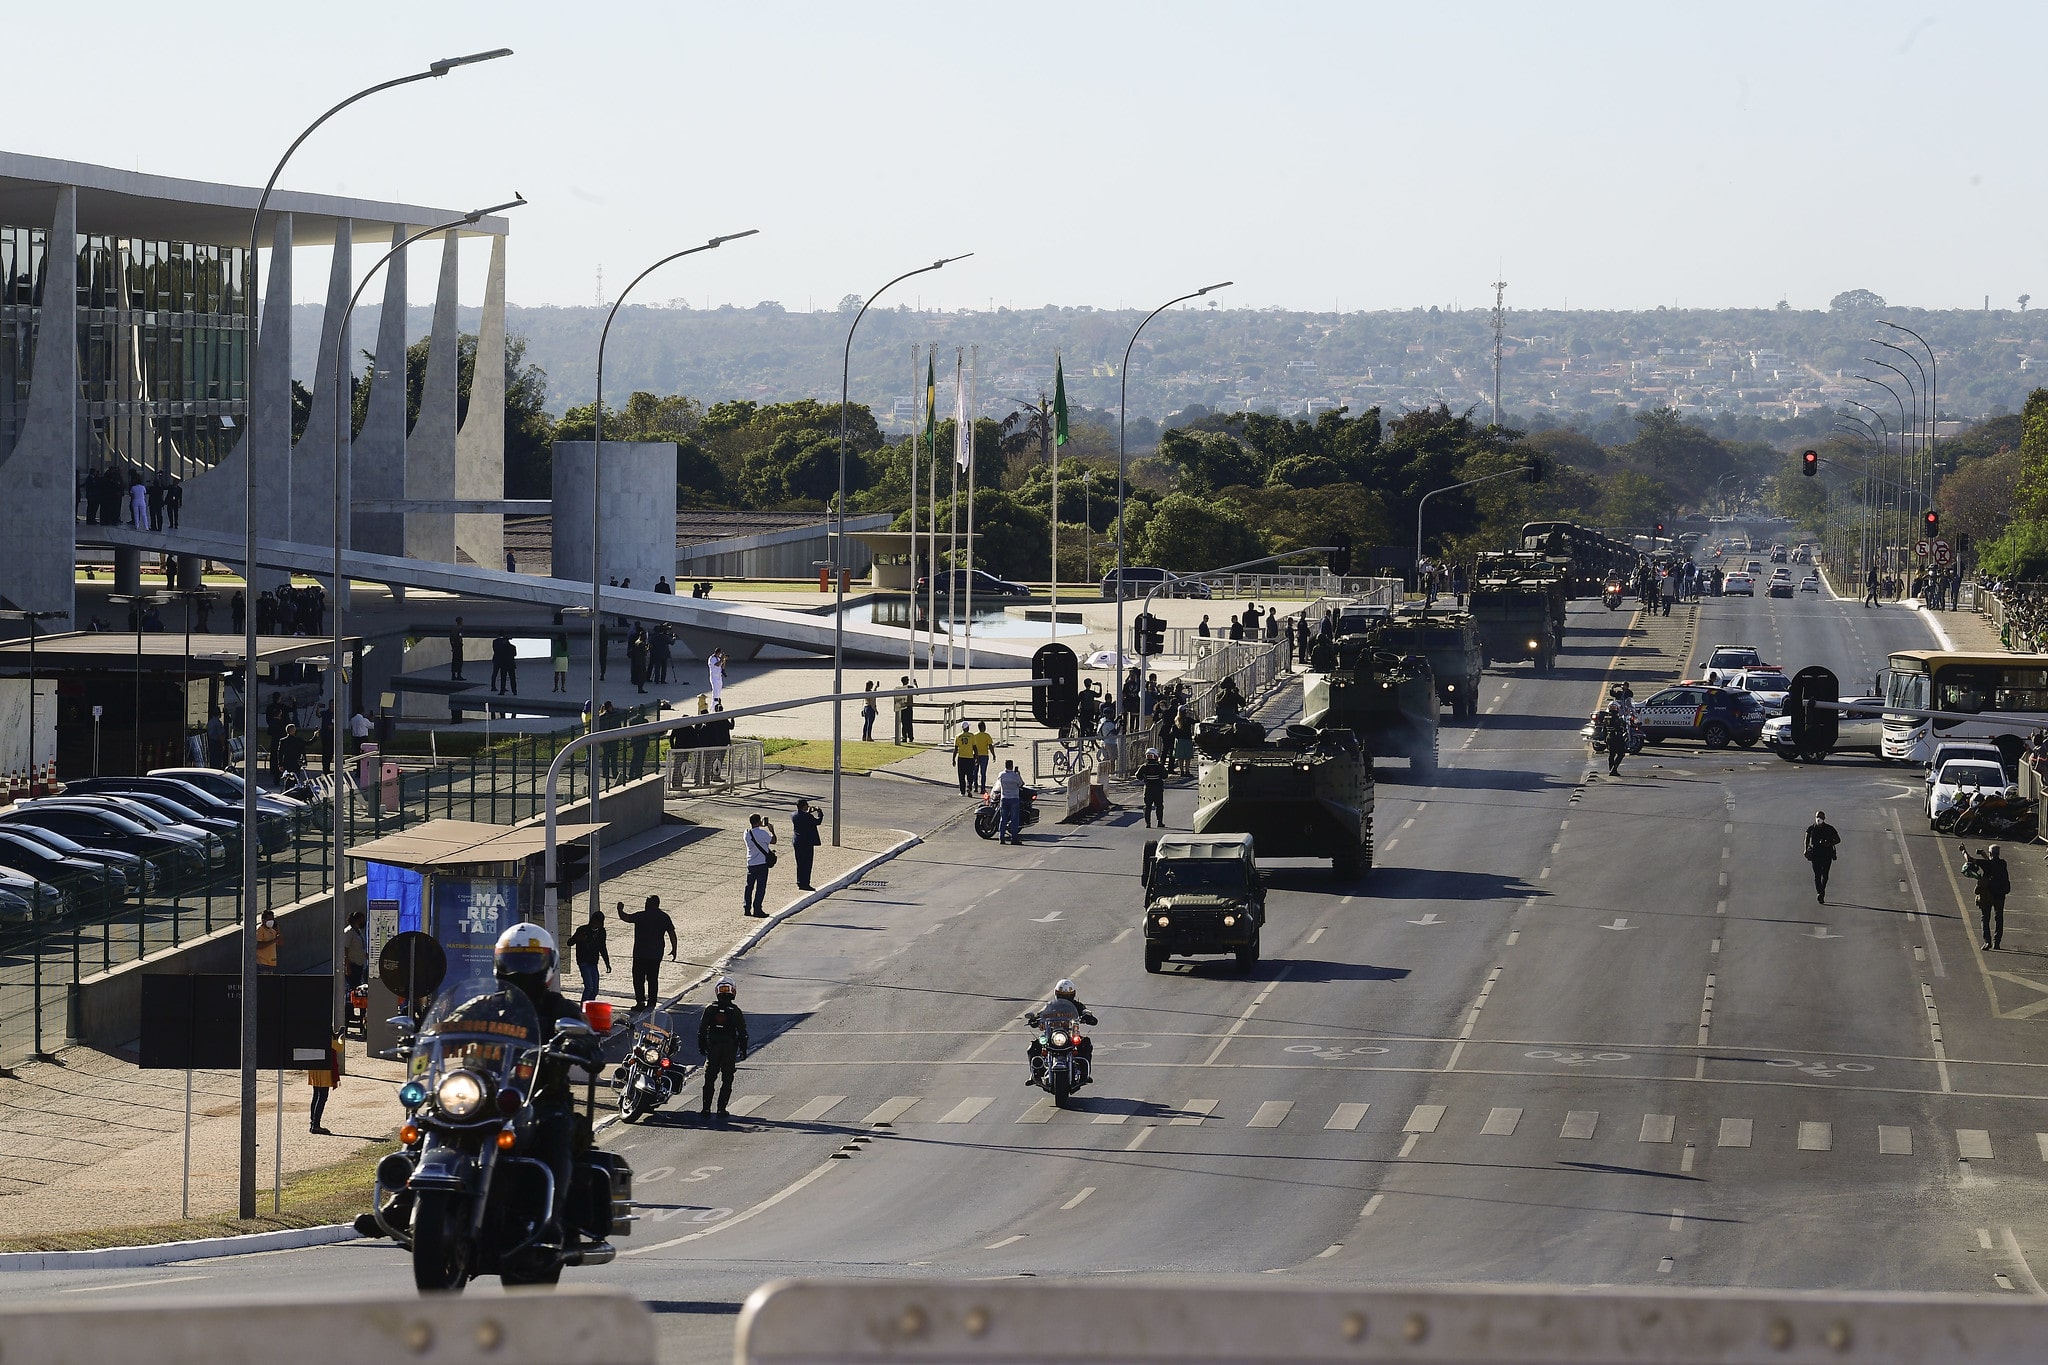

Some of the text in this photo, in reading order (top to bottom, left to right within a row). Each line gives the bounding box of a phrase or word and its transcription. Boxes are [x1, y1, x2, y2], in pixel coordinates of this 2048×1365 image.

[961, 737, 969, 745] 10
[476, 893, 506, 907] MA
[467, 906, 499, 920] RIS
